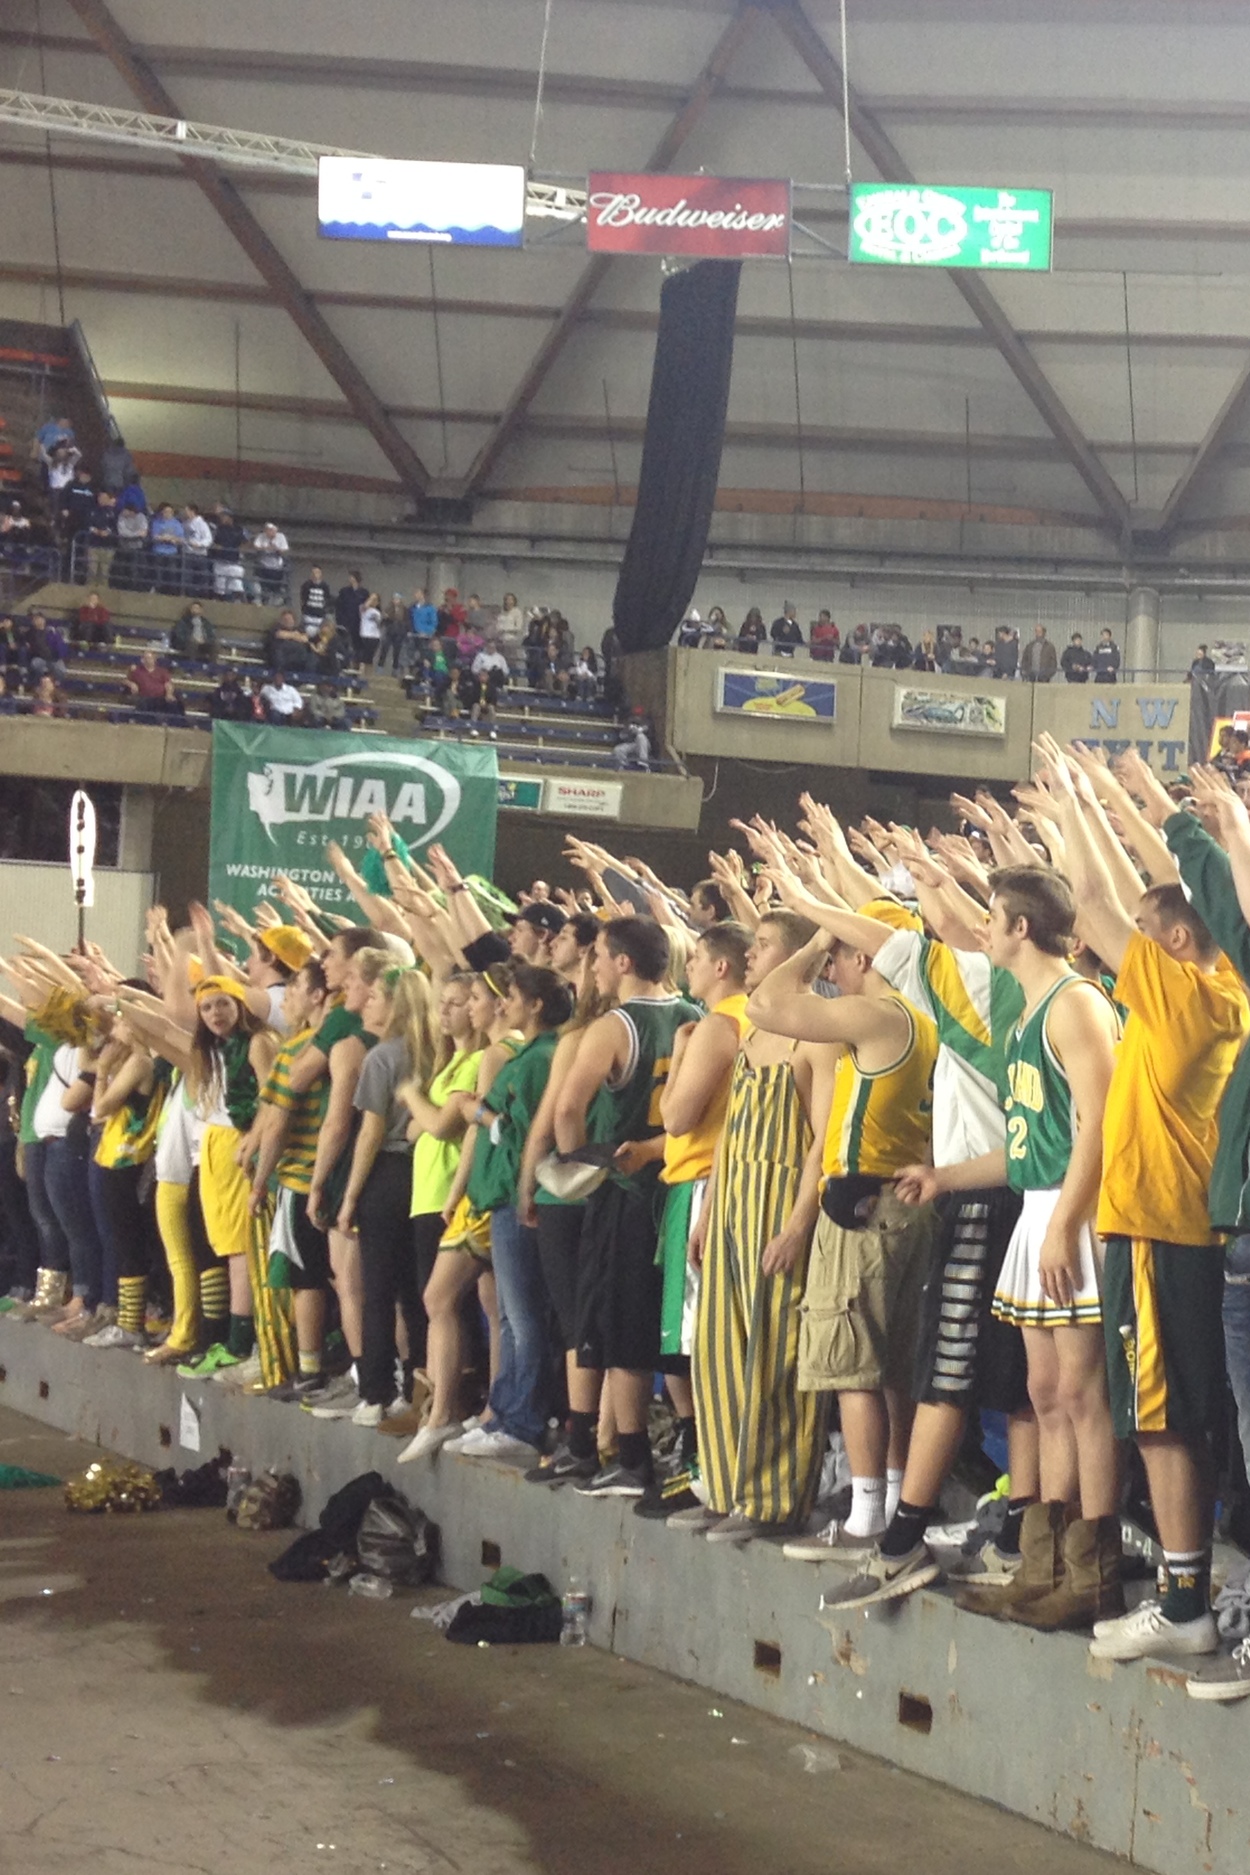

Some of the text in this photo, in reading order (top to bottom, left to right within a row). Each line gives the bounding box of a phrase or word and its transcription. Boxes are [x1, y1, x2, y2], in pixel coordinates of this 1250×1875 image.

[589, 192, 785, 232] Budweiser
[283, 772, 427, 824] WIAA
[558, 786, 606, 798] SHARP
[226, 864, 335, 883] WASHINGTON
[1007, 1115, 1028, 1159] 2
